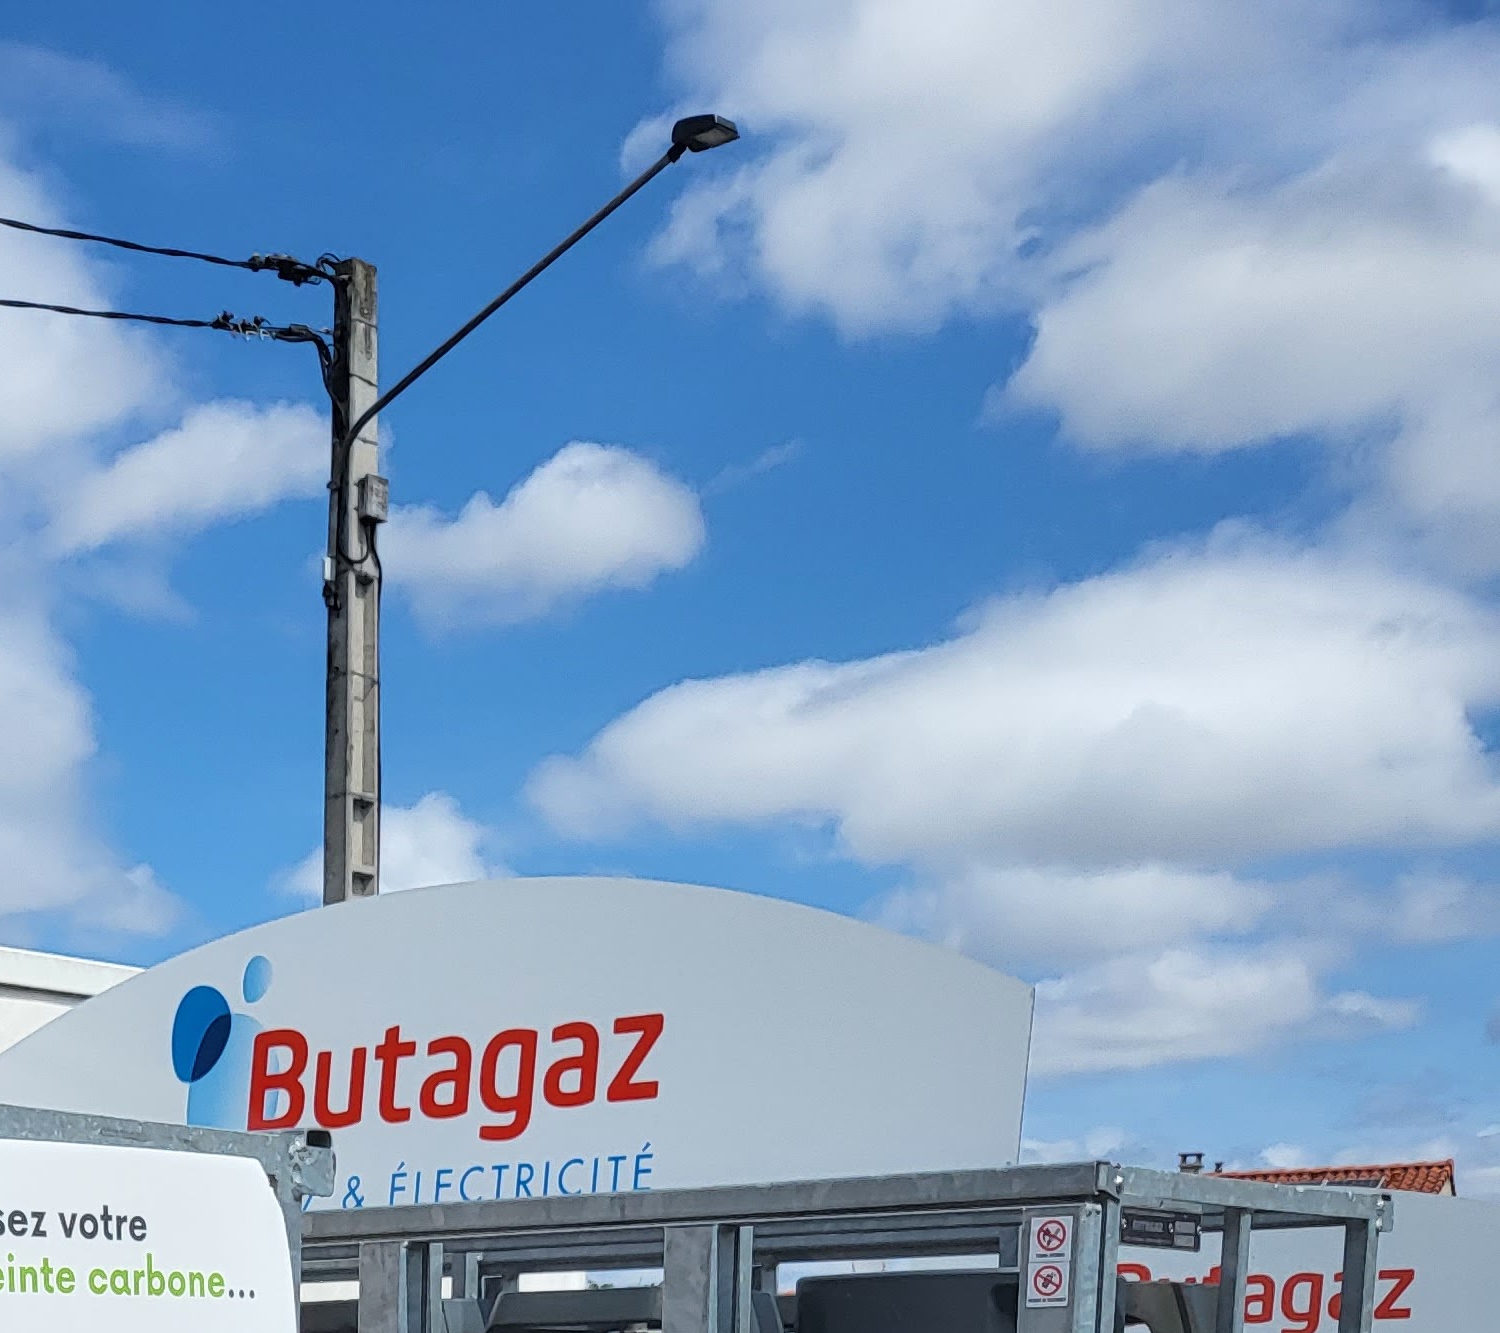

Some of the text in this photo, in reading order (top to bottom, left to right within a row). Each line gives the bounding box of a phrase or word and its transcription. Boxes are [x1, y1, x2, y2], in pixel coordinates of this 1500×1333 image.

[246, 1013, 663, 1141] Butagaz
[57, 1204, 148, 1241] votre
[88, 1253, 256, 1300] carbone...
